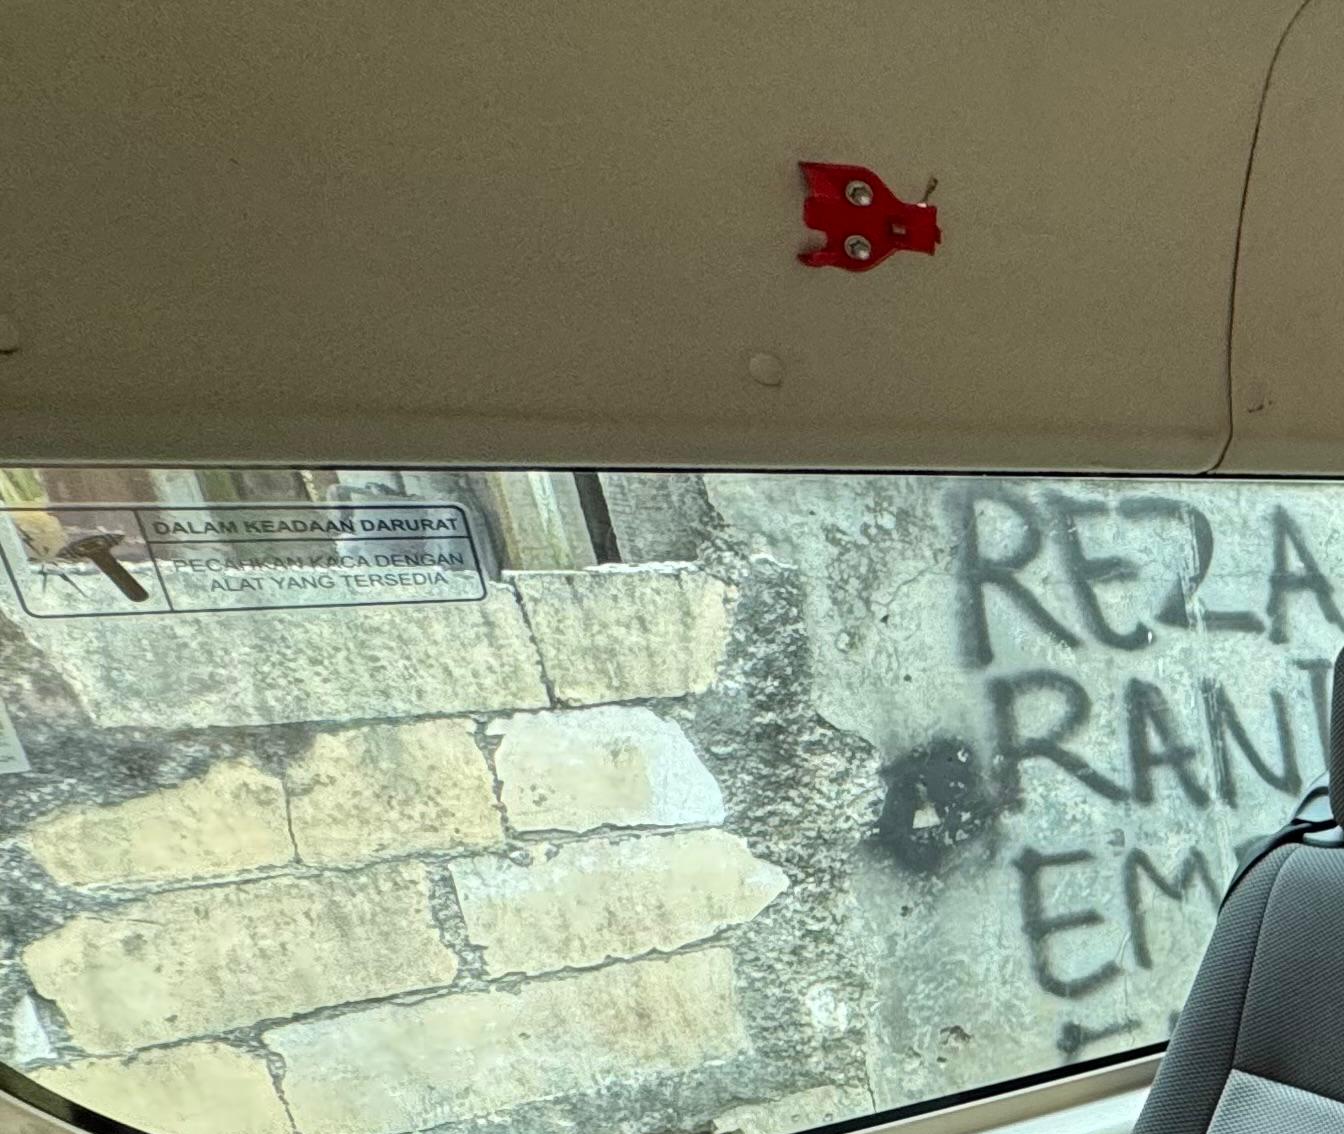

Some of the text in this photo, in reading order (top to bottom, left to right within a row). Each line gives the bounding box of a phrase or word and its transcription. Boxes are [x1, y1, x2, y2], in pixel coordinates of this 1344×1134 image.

[152, 518, 458, 535] DALAM KEADAAN DARURAT
[172, 552, 465, 573] PECAHKAN KACA DENGAN
[210, 572, 449, 592] ALAT YANG TERSEDIA
